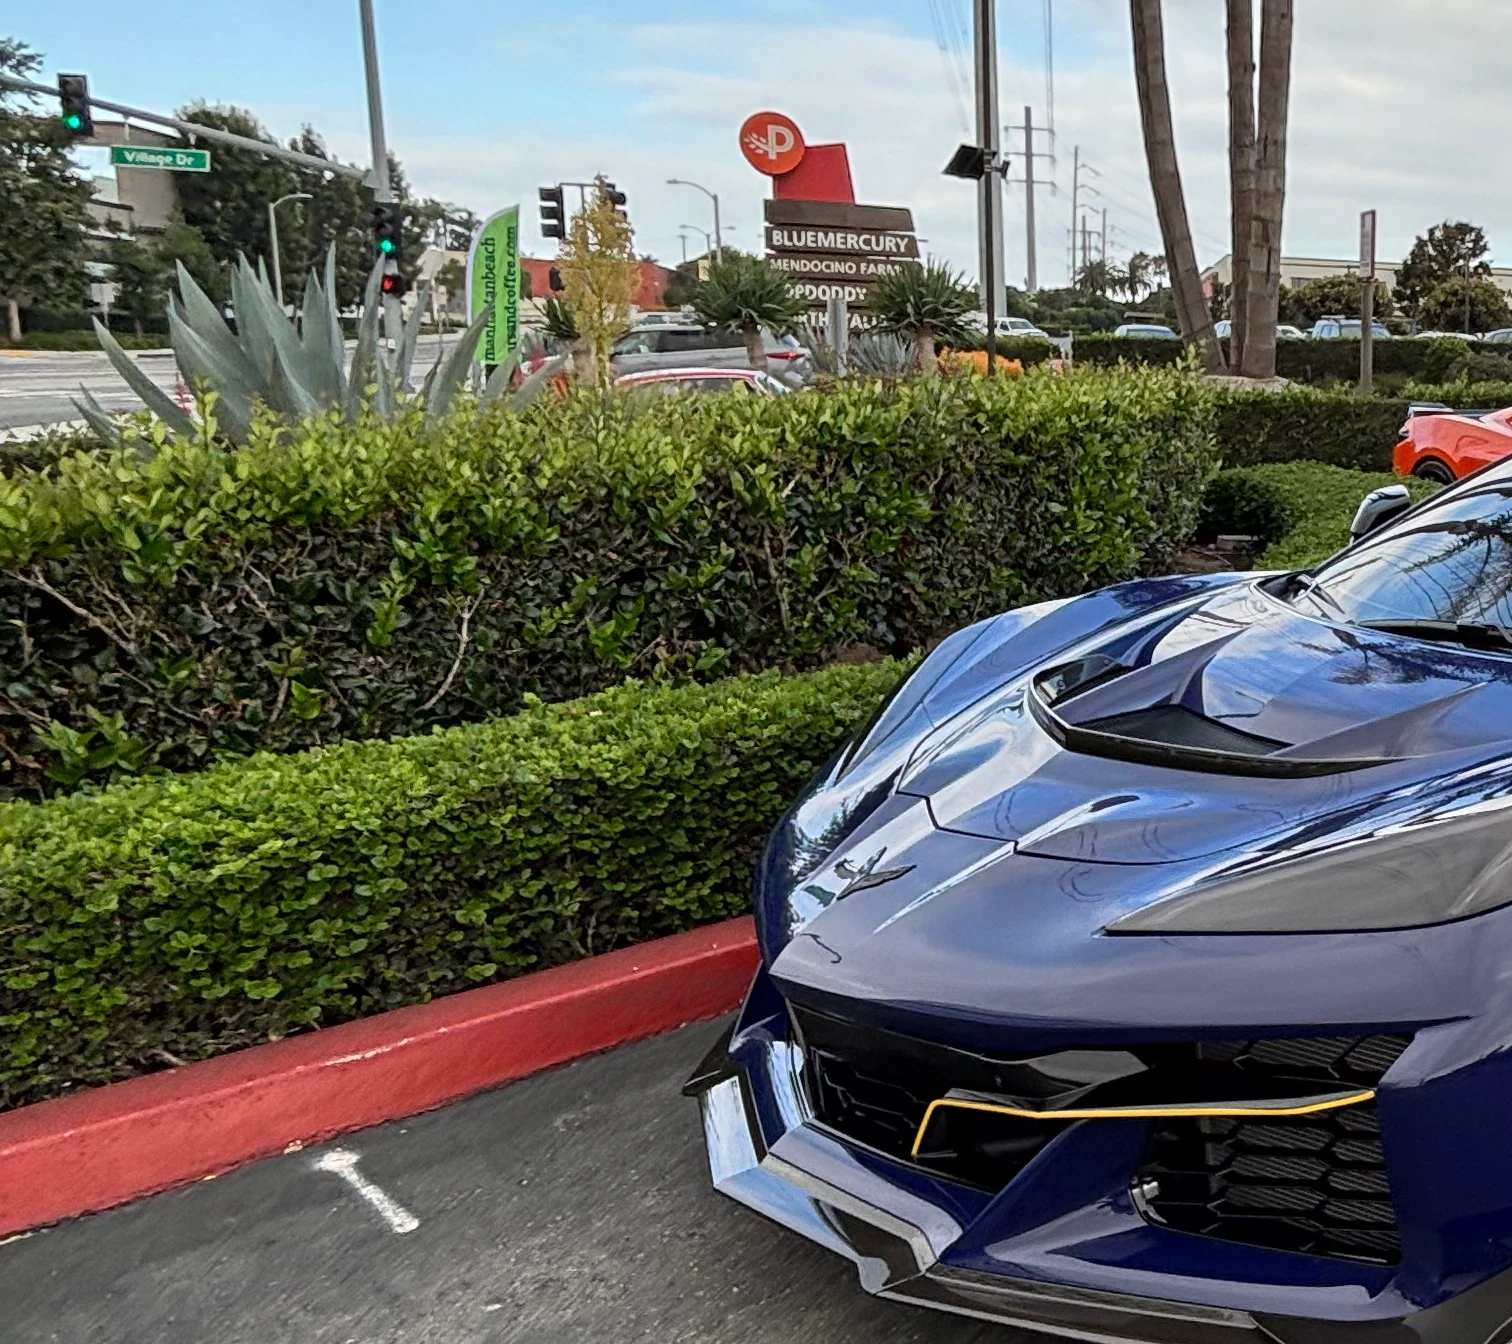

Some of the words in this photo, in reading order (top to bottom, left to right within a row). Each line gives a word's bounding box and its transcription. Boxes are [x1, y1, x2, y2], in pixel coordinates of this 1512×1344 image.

[123, 151, 173, 167] Village
[176, 153, 194, 165] Dr
[772, 229, 908, 253] BLUEMERCURY
[769, 258, 857, 274] MENDOCINO
[480, 237, 496, 361] manhatanbeach
